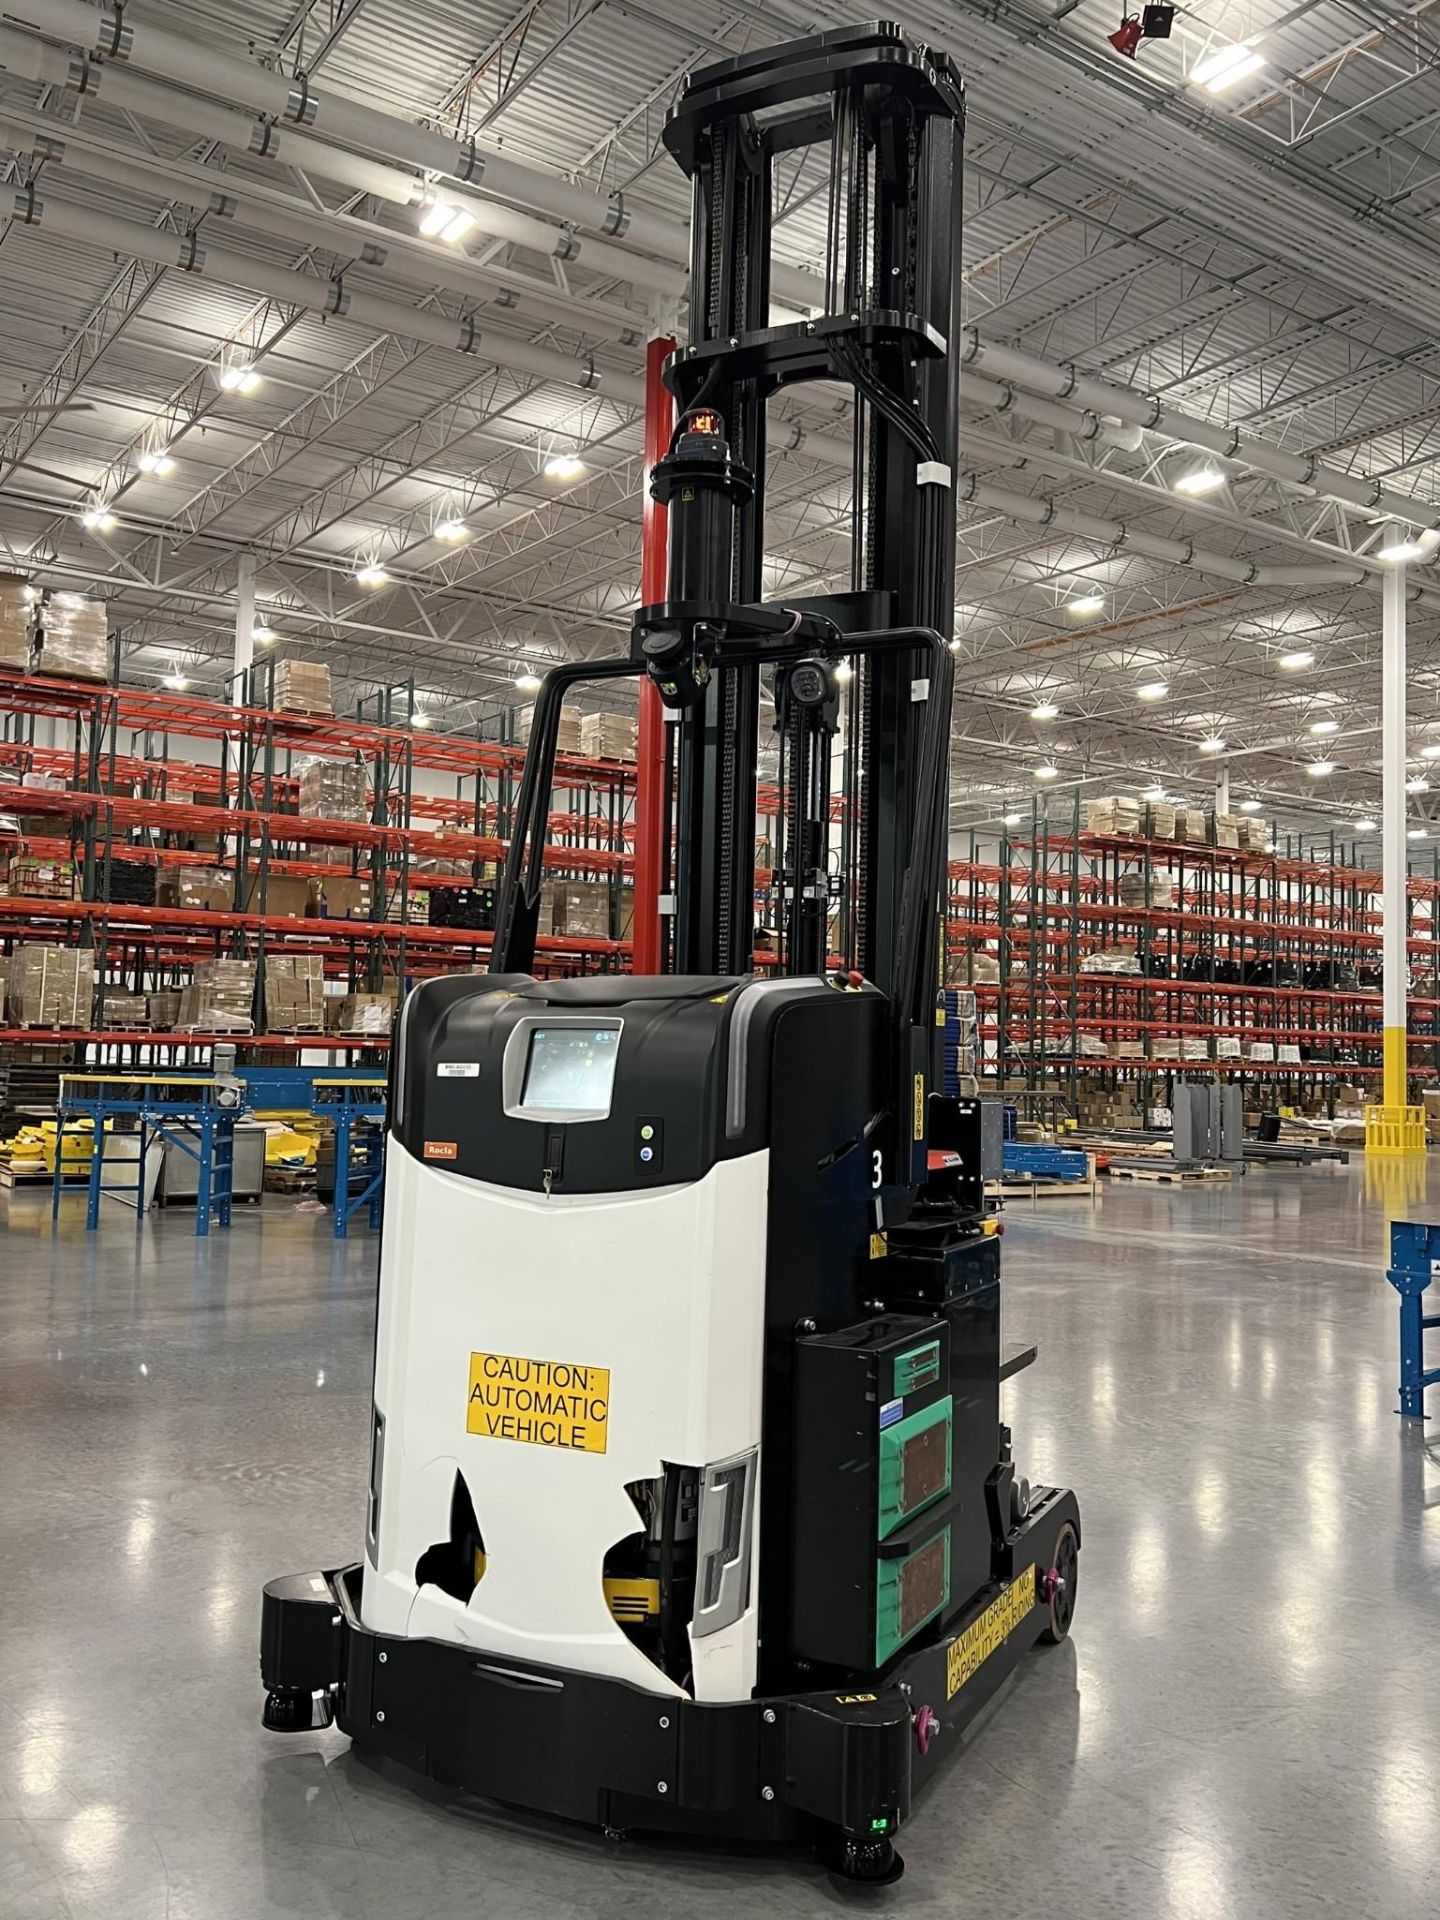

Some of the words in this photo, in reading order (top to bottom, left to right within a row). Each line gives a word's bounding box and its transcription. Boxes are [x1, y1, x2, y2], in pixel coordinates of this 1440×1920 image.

[429, 1145, 453, 1155] Rocla
[872, 1150, 883, 1189] 3
[483, 1356, 595, 1392] CAUTION:
[470, 1383, 606, 1422] AUTOMATIC
[486, 1413, 586, 1449] VEHICLE
[1018, 1571, 1030, 1594] NO
[1012, 1589, 1035, 1628] RIDING
[948, 1616, 987, 1668] MAXIMUM
[987, 1590, 1013, 1628] GRADE
[949, 1632, 994, 1695] CAPABILITY
